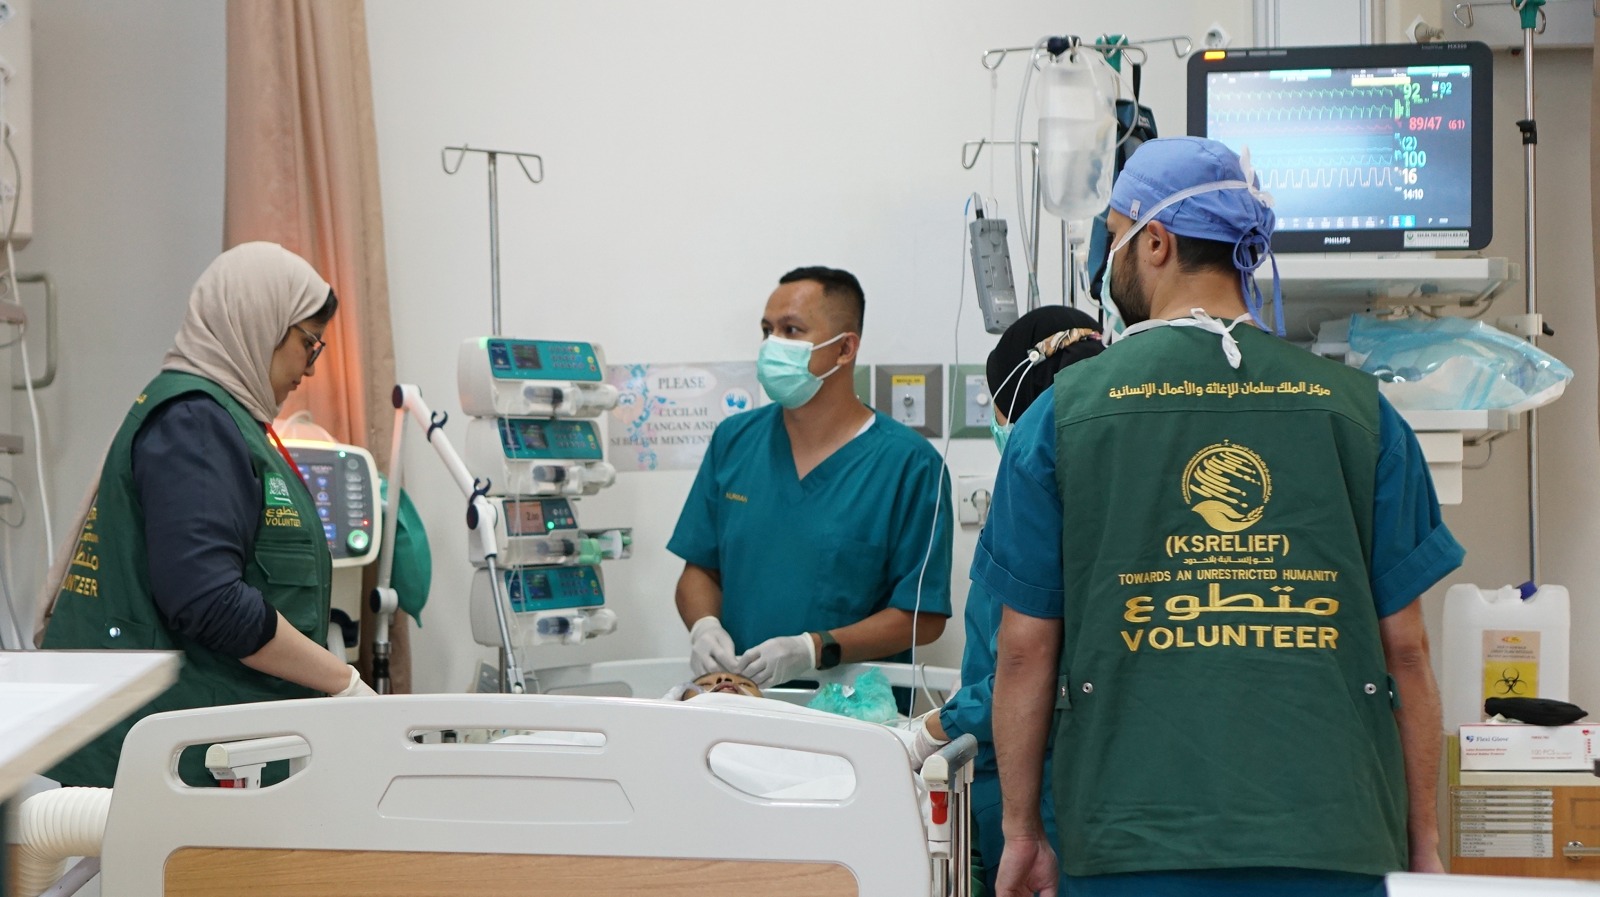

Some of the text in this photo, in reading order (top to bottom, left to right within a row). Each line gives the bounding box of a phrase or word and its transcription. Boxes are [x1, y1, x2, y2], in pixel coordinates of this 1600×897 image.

[1403, 82, 1452, 99] 92 92
[1409, 116, 1465, 131] 89/47 (61)
[1402, 136, 1417, 151] (2)
[1403, 151, 1427, 168] 100
[1402, 168, 1417, 185] 16
[1323, 236, 1351, 245] PHILIPS
[658, 376, 706, 390] PLEASE
[1109, 382, 1156, 399] الإنسانية
[1158, 380, 1203, 396] والأعمال
[1241, 381, 1274, 394] سلمان
[1276, 381, 1306, 393] الملك
[1307, 383, 1331, 396] مركز
[647, 420, 718, 432] TANGAN AND
[661, 435, 712, 446] MENYENT
[1166, 534, 1290, 558] (KSRELIEF)
[1118, 569, 1338, 584] TOWARDS AN UNRESTRICTED HUMANITY
[1123, 582, 1340, 623] متطوع
[1120, 624, 1339, 652] VOLUNTEER
